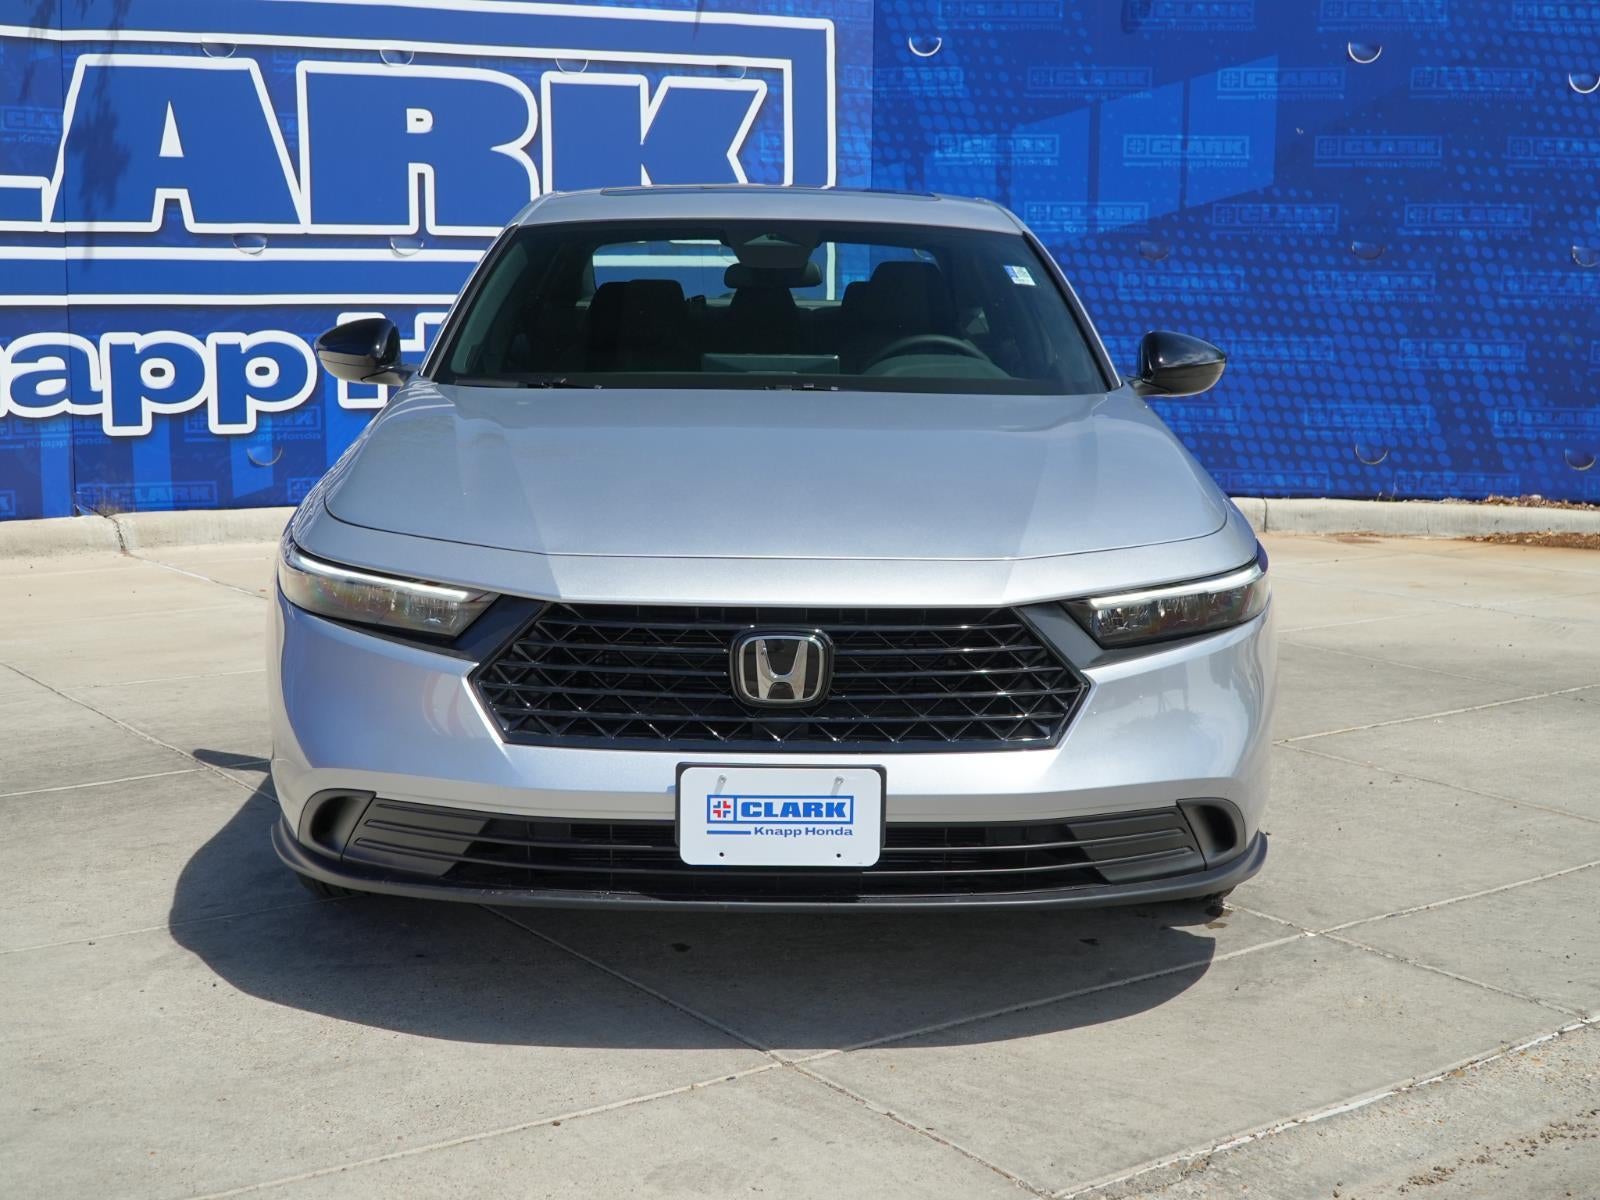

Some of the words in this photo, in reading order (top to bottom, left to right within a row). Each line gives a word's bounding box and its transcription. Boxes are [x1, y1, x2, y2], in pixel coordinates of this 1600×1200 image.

[1055, 71, 1147, 85] CLARK
[1246, 72, 1340, 86] CLARK
[6, 111, 59, 129] CLA
[0, 53, 768, 235] ARK
[1151, 139, 1246, 154] CLARK
[1343, 140, 1437, 154] CLARK
[1052, 206, 1143, 220] CLARK
[1240, 207, 1333, 222] CLARK
[0, 330, 317, 436] app
[740, 801, 847, 818] CLARK
[753, 826, 802, 838] Knapp
[805, 826, 854, 836] Honda
